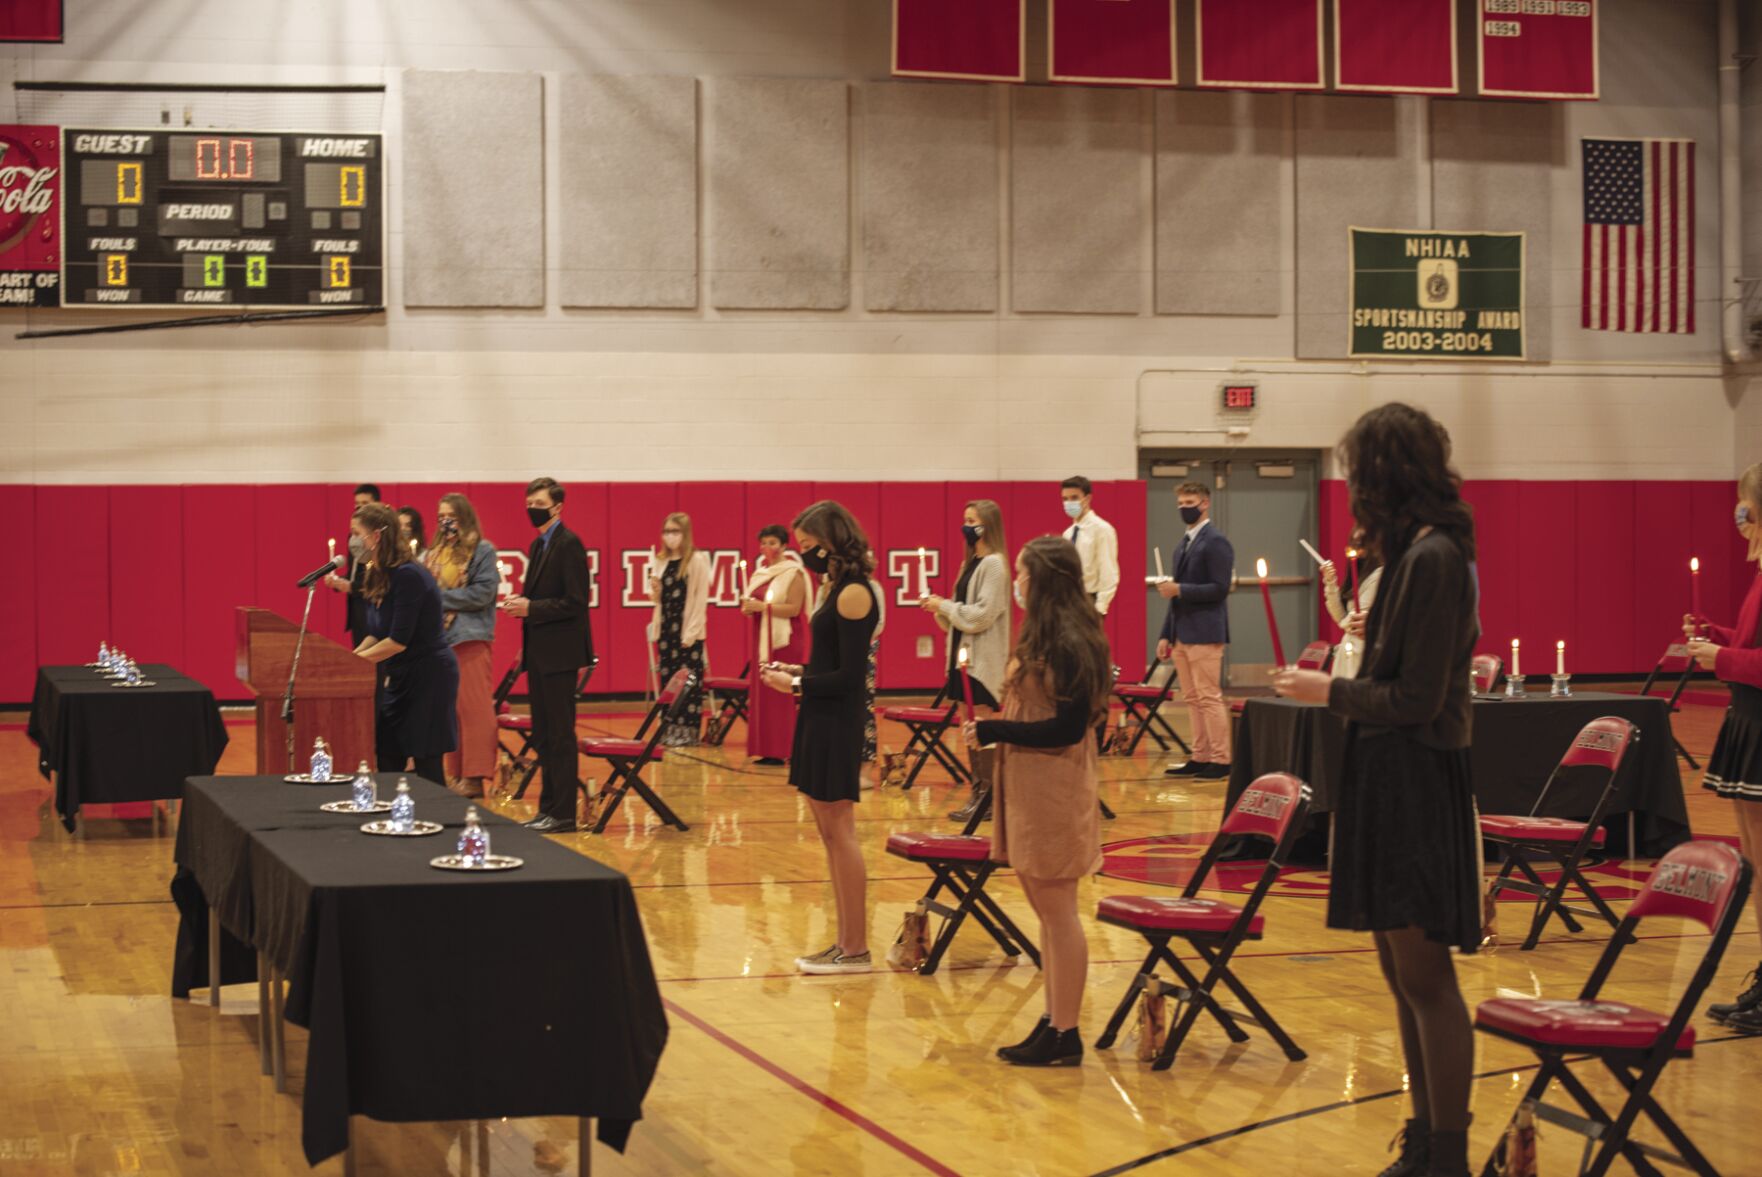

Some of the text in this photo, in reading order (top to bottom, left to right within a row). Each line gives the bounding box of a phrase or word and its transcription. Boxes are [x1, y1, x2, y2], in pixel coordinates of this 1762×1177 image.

[1523, 1, 1552, 13] 1991
[1559, 2, 1588, 15] 1993
[1488, 22, 1517, 35] 1994
[75, 135, 150, 153] GUEST
[302, 139, 368, 156] HOME
[196, 137, 253, 179] 0.0
[117, 163, 142, 204] 0
[340, 166, 365, 207] 0
[166, 205, 234, 219] PERIOD
[90, 238, 135, 250] FOULS
[176, 239, 273, 251] PLAYER-FOUL
[313, 240, 359, 252] FOULS
[1405, 238, 1471, 258] NHIAA
[107, 255, 128, 286] 0
[330, 255, 350, 287] 0
[35, 273, 59, 288] OF
[96, 289, 129, 301] WON
[184, 290, 226, 302] GAME
[320, 290, 353, 303] WON
[1354, 308, 1521, 330] SPORTSMANSHIP AWARD
[1382, 331, 1493, 351] 2003-2004
[1237, 789, 1291, 821] BELMONT
[1651, 861, 1729, 905] BELMONT
